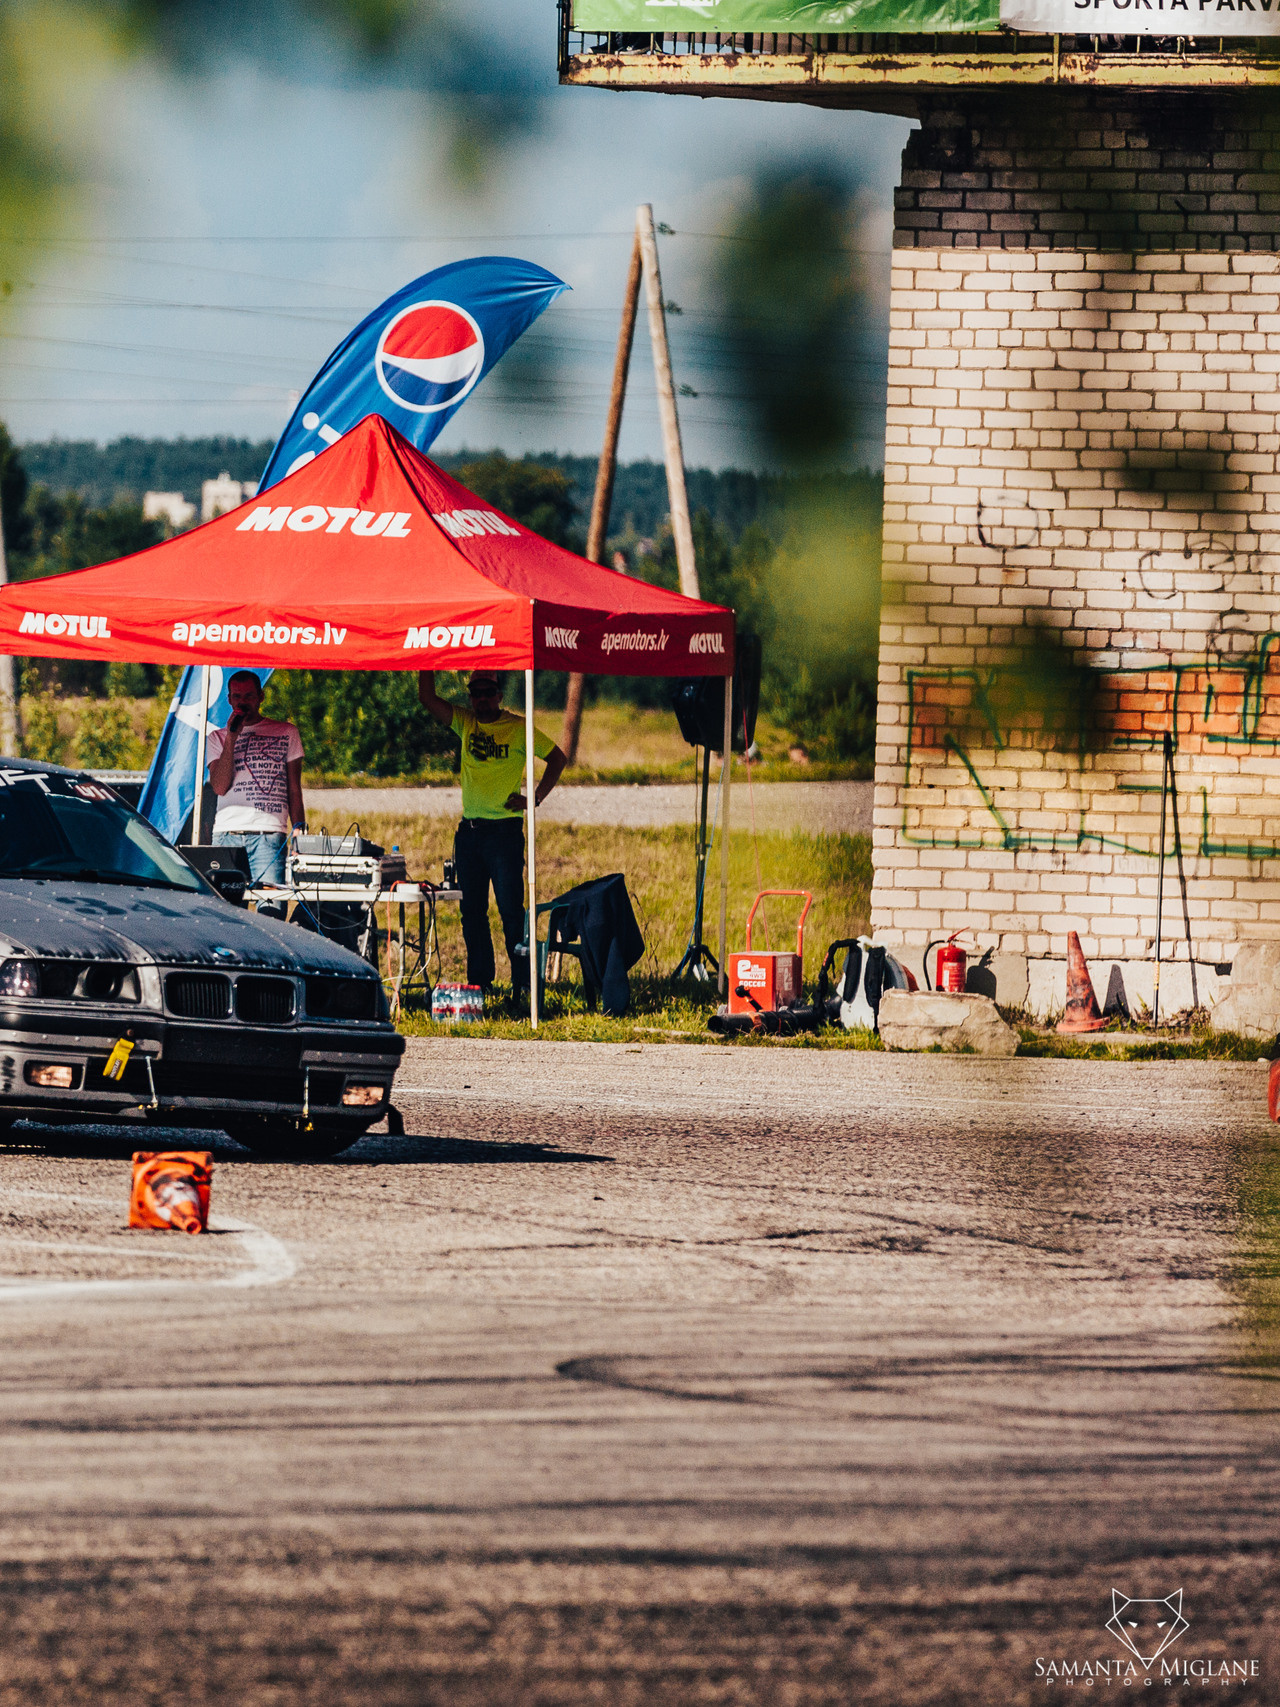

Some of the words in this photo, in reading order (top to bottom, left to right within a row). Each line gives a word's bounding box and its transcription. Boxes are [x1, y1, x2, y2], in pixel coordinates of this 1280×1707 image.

[236, 505, 412, 538] MOTUL
[433, 509, 521, 538] MOTUL
[19, 612, 111, 638] MOTUL
[172, 622, 347, 646] apemotors.lv
[403, 625, 496, 649] MOTUL
[545, 626, 580, 650] MOTUL
[601, 629, 670, 655] apemotors.lv
[689, 633, 725, 654] MOTUL
